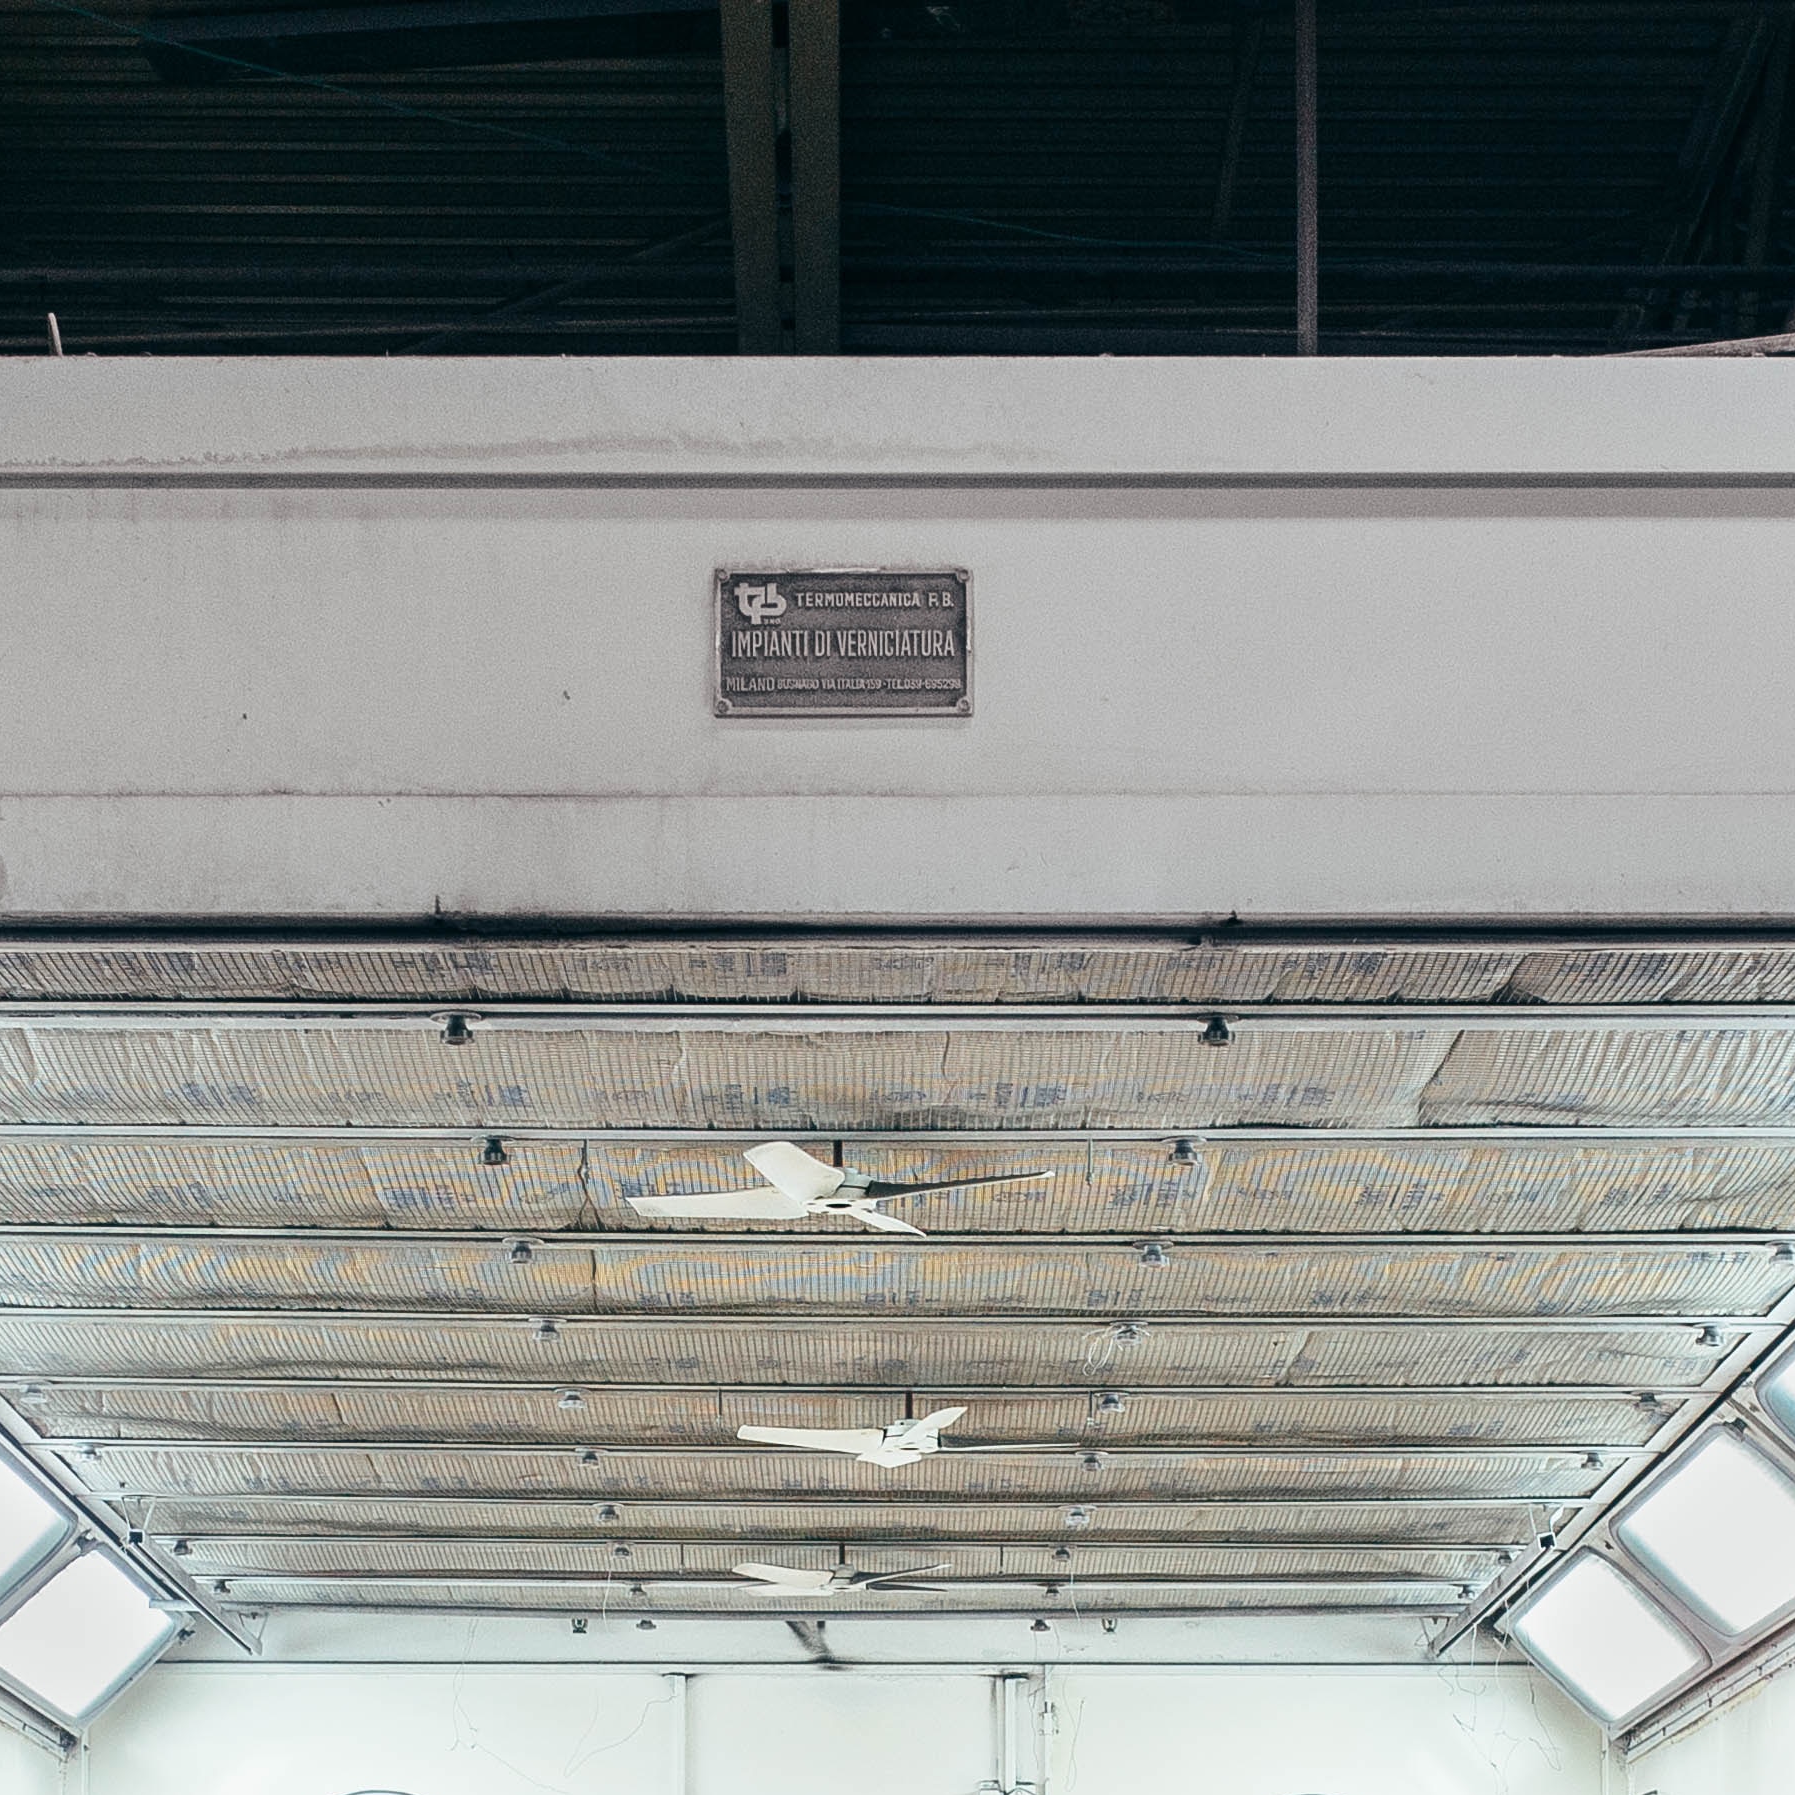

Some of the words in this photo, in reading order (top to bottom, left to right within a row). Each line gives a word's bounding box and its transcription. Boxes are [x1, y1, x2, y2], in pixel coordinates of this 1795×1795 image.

[795, 591, 922, 608] TERMOMECCANICA
[731, 629, 809, 657] IMPIANTI
[814, 629, 831, 657] DI
[835, 628, 955, 657] VERNICIATURA
[726, 677, 775, 692] MILANO
